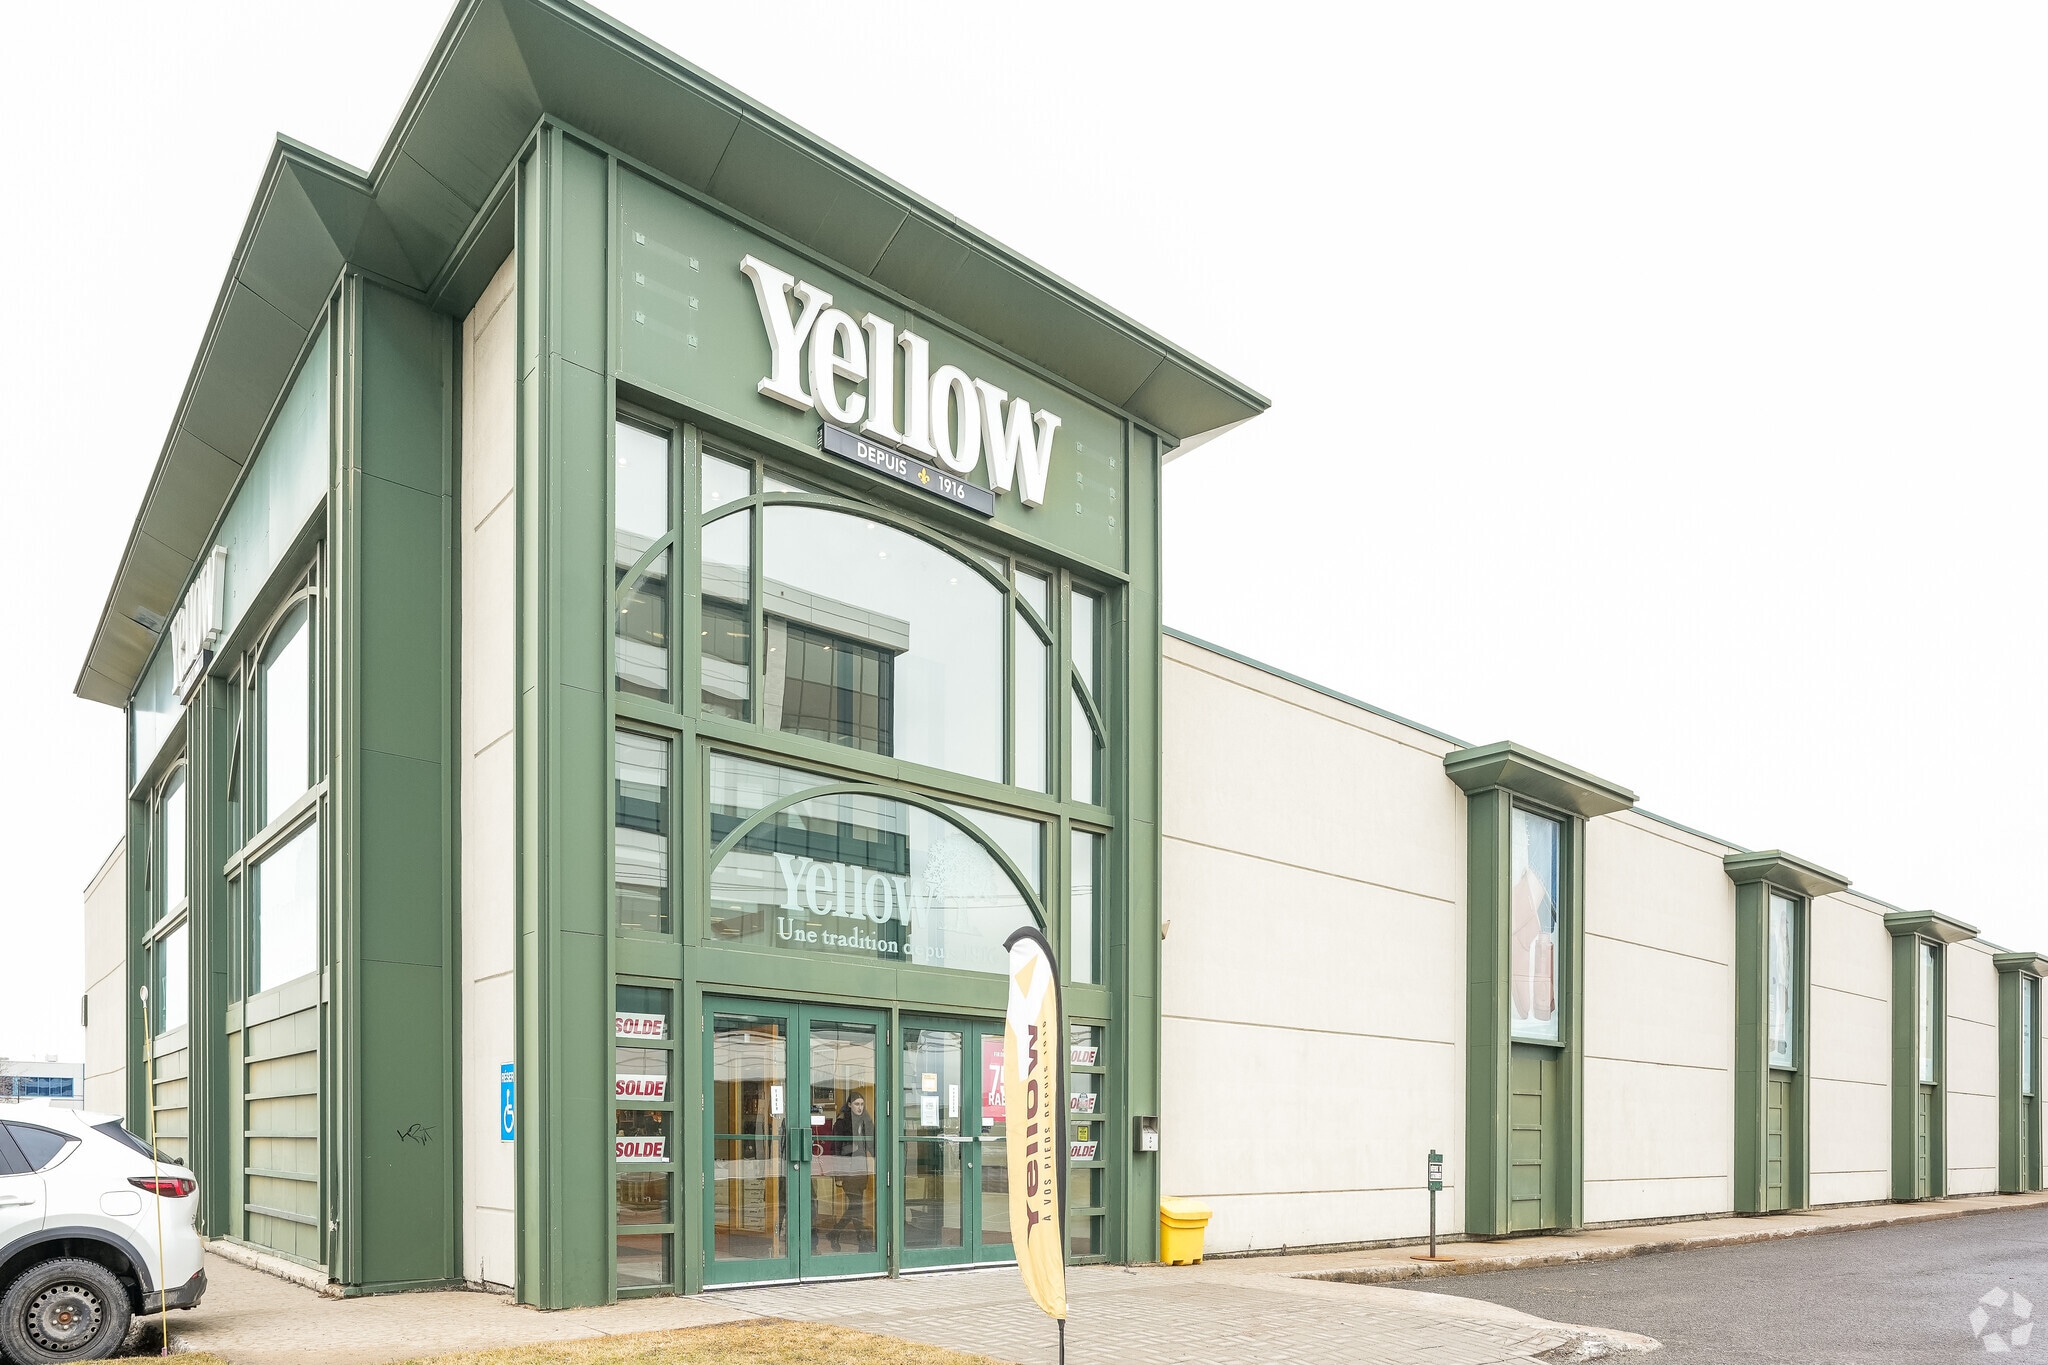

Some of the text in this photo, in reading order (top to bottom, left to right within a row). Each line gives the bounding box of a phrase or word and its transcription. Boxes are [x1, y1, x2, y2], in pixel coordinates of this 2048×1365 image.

[740, 253, 1062, 508] Yellow
[857, 442, 965, 499] DEPUIS 1916
[773, 852, 935, 928] Yellow
[777, 917, 818, 943] Une
[821, 926, 899, 953] tradition
[615, 1017, 662, 1035] SOLDE
[1070, 1050, 1095, 1063] OLDE
[615, 1079, 664, 1097] SOLDE
[615, 1142, 663, 1158] SOLDE
[1070, 1145, 1095, 1157] OLDE
[1043, 1179, 1052, 1205] VOS
